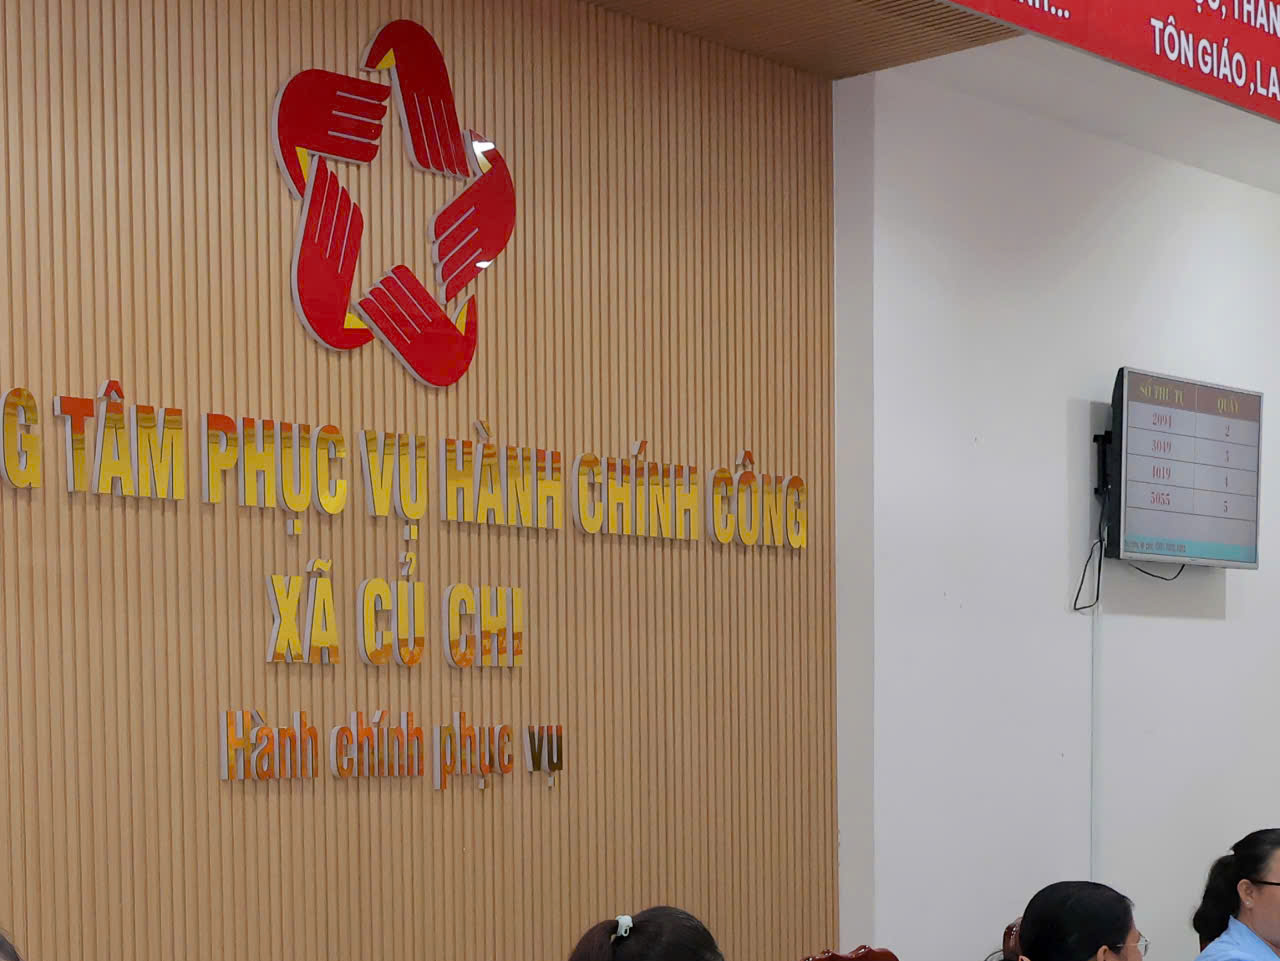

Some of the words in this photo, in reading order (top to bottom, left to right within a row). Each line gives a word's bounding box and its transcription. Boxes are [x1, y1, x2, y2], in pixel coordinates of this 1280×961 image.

[1150, 15, 1194, 69] TÔN
[54, 379, 186, 501] TÂM
[201, 412, 348, 536] PHỤC
[358, 429, 427, 541] VỤ
[440, 418, 562, 530] HÀNH
[572, 440, 699, 541] CHÍNH
[706, 449, 807, 549] CÔNG
[266, 558, 341, 665] XÃ
[357, 551, 425, 667] CỦ
[442, 582, 524, 669] CHI
[220, 709, 319, 781] Hành
[330, 709, 425, 779] chính
[433, 710, 514, 791] phục
[523, 725, 563, 790] vụ
